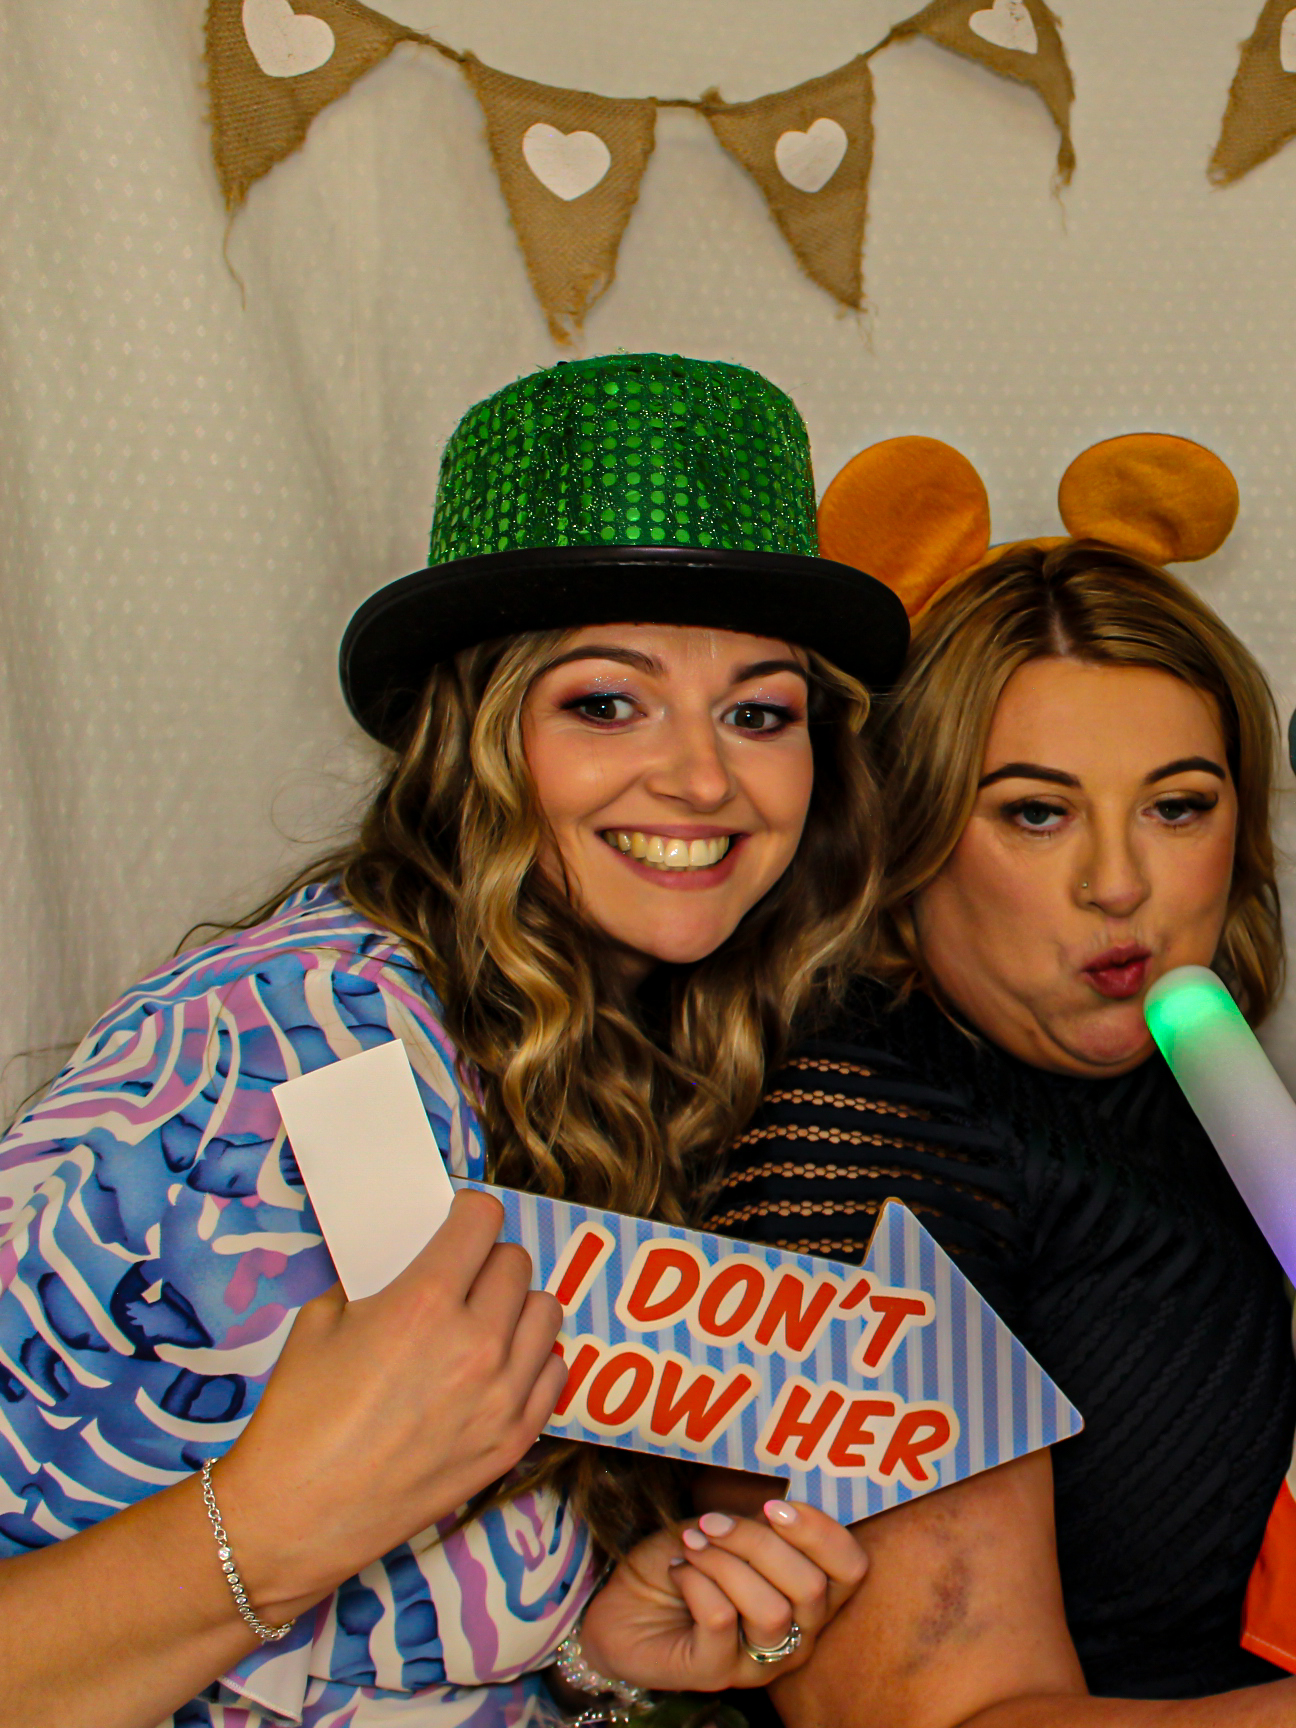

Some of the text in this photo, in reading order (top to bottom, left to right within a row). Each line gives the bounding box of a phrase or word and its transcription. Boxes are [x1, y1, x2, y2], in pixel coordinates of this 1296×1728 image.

[555, 1231, 926, 1369] I DON'T
[765, 1384, 951, 1482] HER
